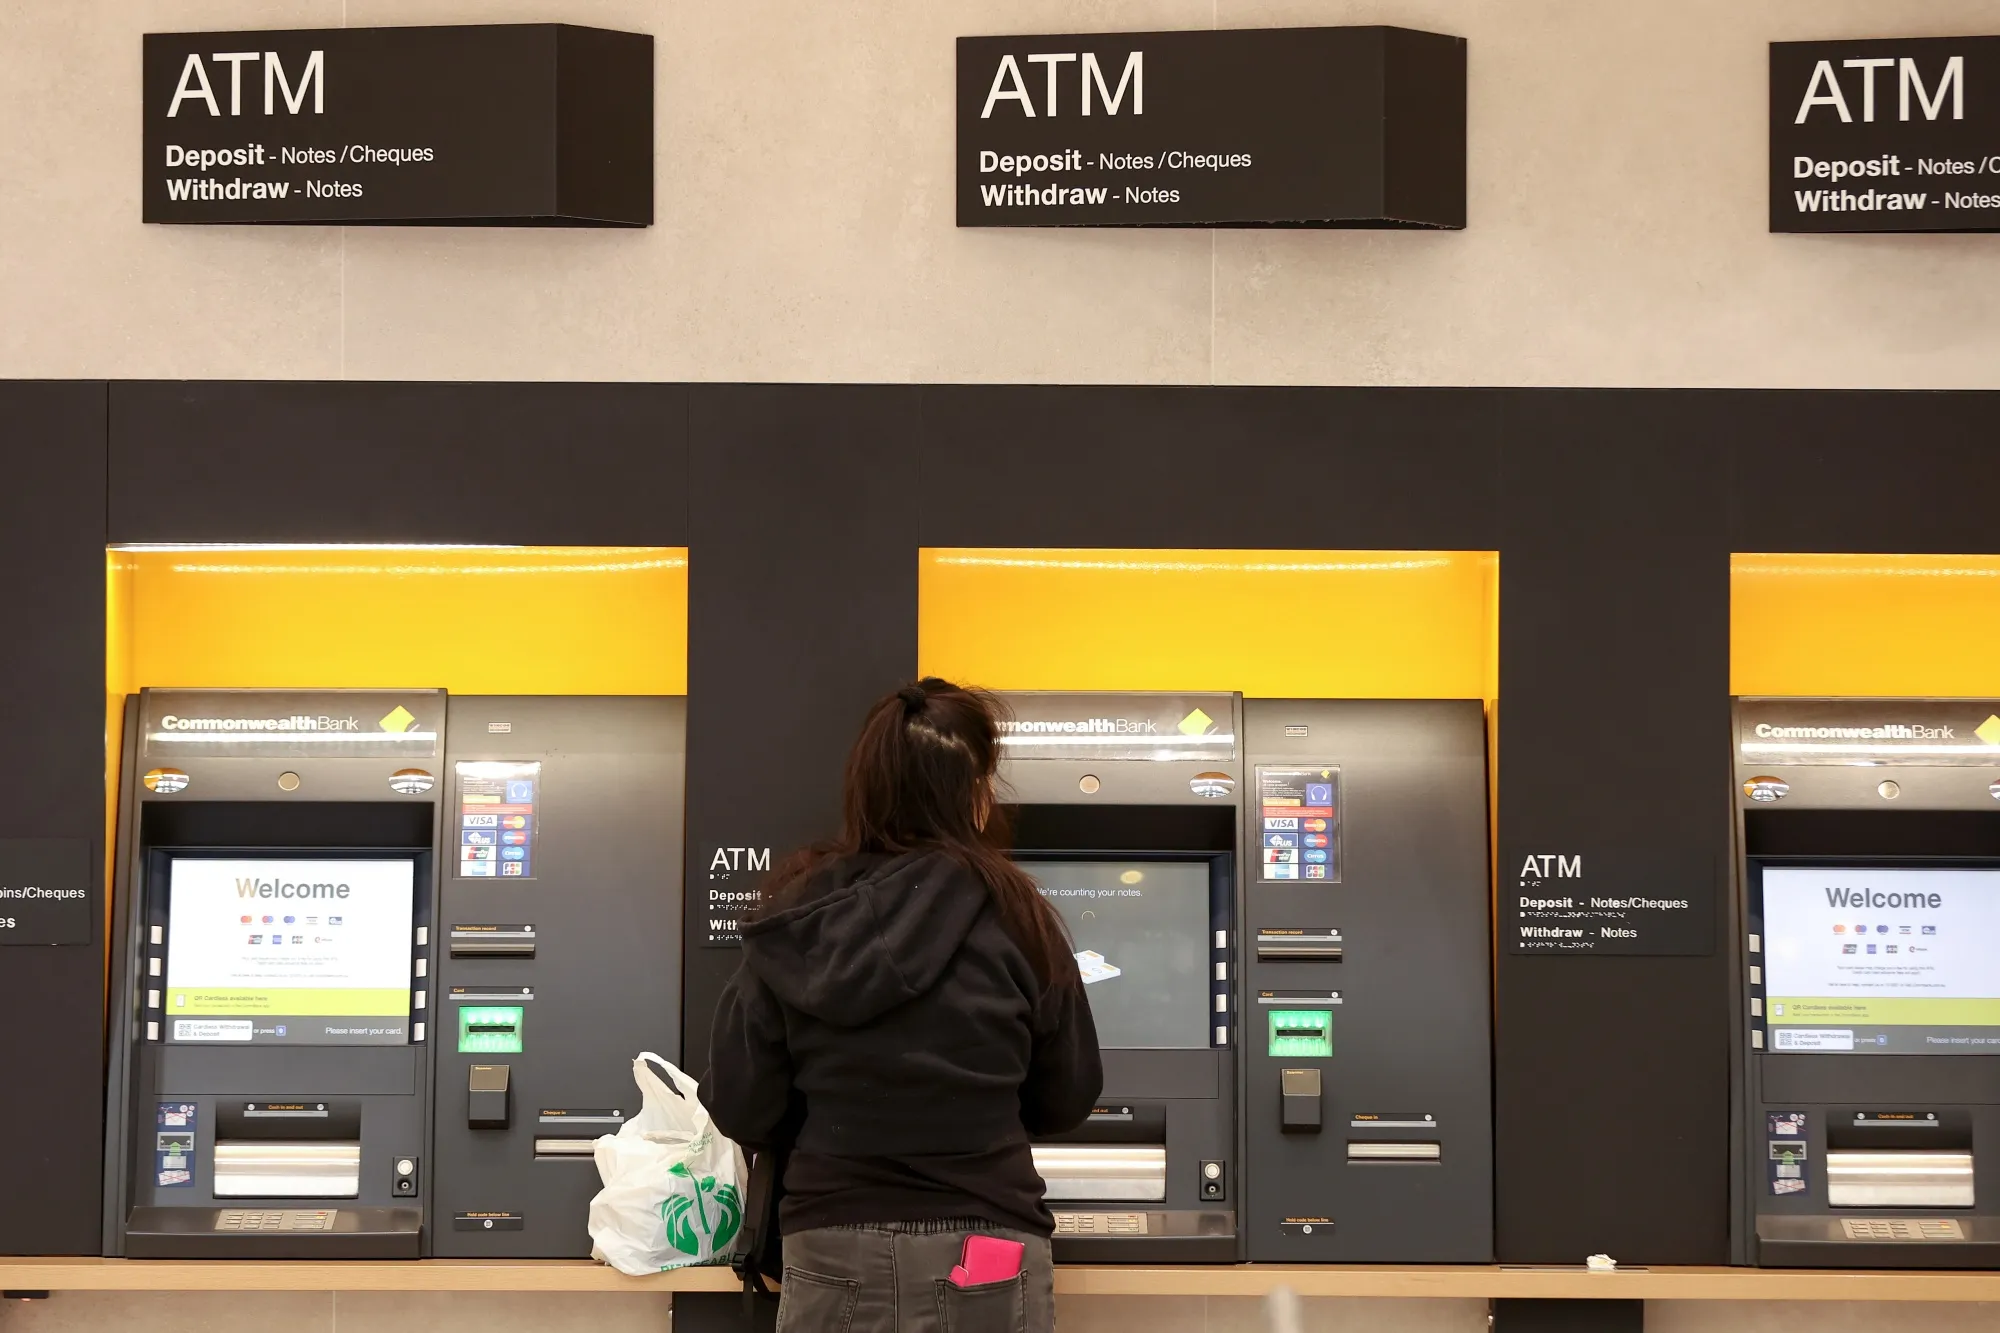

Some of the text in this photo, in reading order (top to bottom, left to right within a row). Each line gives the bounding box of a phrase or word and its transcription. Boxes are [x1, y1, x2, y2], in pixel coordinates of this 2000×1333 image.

[166, 50, 324, 118] ATM
[980, 51, 1143, 119] ATM
[1794, 56, 1964, 124] ATM
[166, 143, 265, 171] Deposit
[281, 147, 336, 164] Notes
[980, 149, 1082, 177] Deposit
[1099, 153, 1154, 170] Notes
[1793, 154, 1900, 183] Deposit
[1918, 158, 1975, 175] Notes
[166, 178, 289, 200] Withdraw
[306, 180, 363, 198] Notes
[980, 183, 1107, 207] Withdraw
[1125, 186, 1180, 204] Notes
[1794, 189, 1927, 213] Withdraw
[1945, 192, 2000, 209] Notes
[161, 715, 359, 731] CommonwealthBank
[1755, 723, 1954, 739] CommonwealthBank
[469, 816, 493, 825] VISA
[1270, 819, 1294, 828] VISA
[1276, 839, 1292, 847] PLUS
[709, 847, 770, 871] ATM
[1520, 854, 1581, 878] ATM
[235, 878, 350, 899] Welcome
[709, 890, 761, 903] Deposit
[1060, 888, 1095, 898] counting
[1098, 889, 1115, 898] your
[1118, 889, 1143, 897] notes.
[1825, 888, 1941, 908] Welcome
[1519, 897, 1573, 910] Deposit
[1590, 897, 1688, 910] Notes/Cheques
[1520, 926, 1583, 938] Withdraw
[1601, 927, 1637, 938] Notes
[369, 1027, 384, 1036] your
[1926, 1036, 1949, 1044] Please
